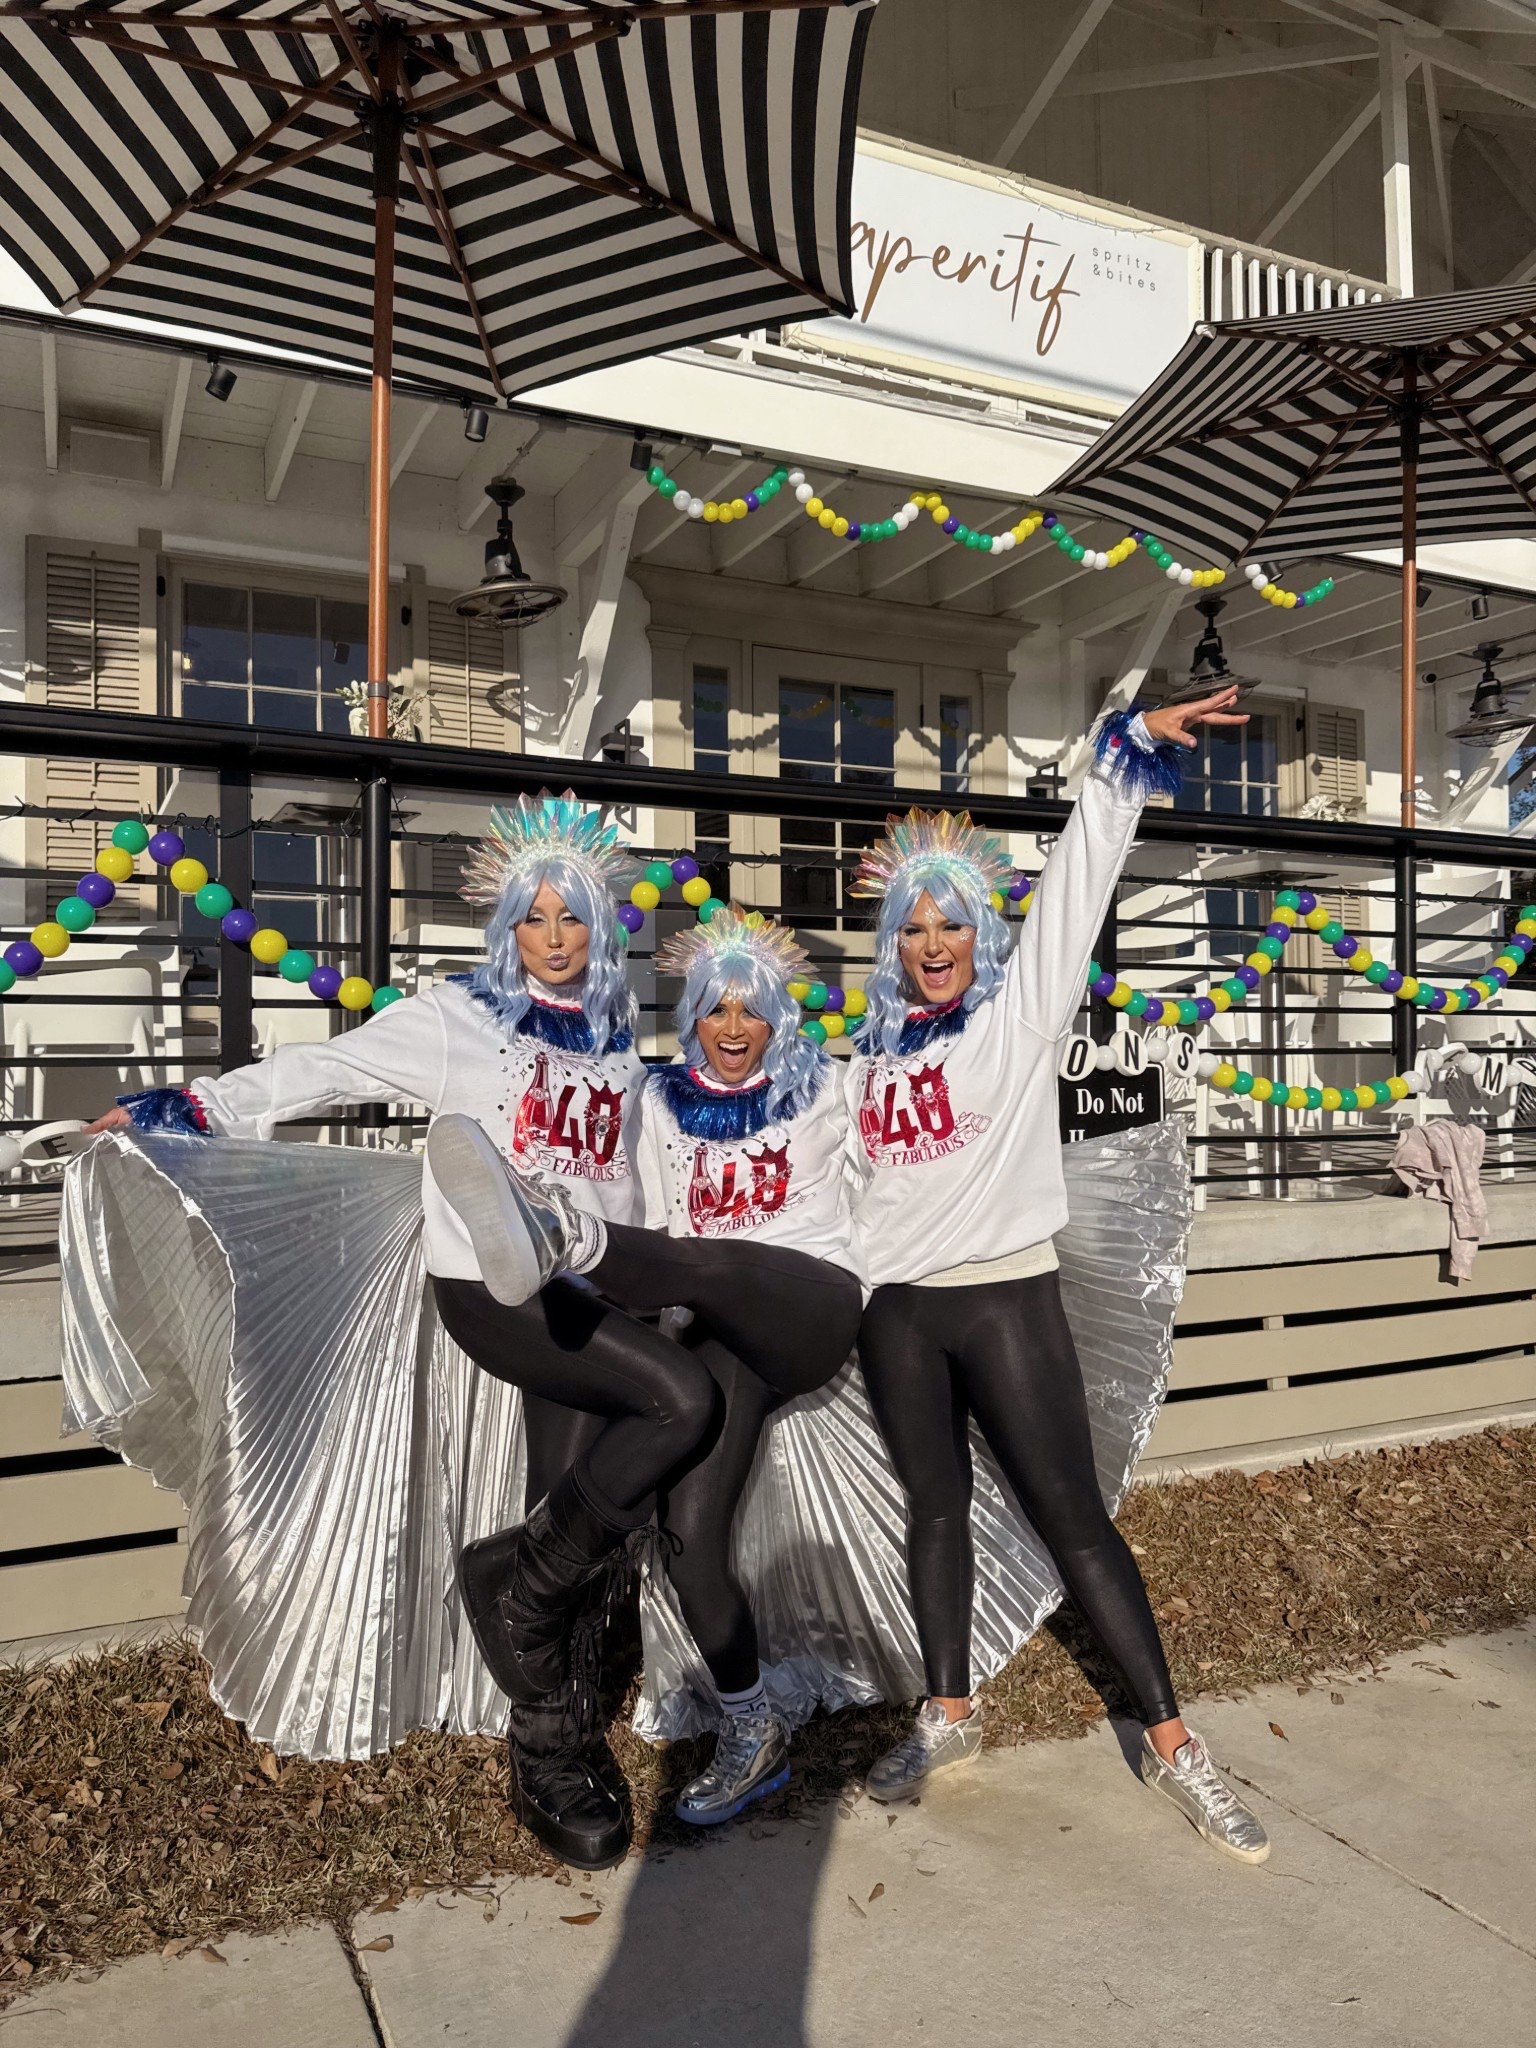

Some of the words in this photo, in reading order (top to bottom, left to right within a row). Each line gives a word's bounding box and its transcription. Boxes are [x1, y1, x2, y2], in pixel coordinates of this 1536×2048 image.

[1092, 247, 1152, 272] spritz
[850, 221, 1081, 357] aperitif
[881, 1080, 955, 1149] 40
[1075, 1088, 1105, 1115] Do
[1110, 1087, 1145, 1114] Not
[548, 1084, 622, 1166] 40
[892, 1135, 965, 1165] FABULOUS
[553, 1159, 615, 1181] FABULOUS
